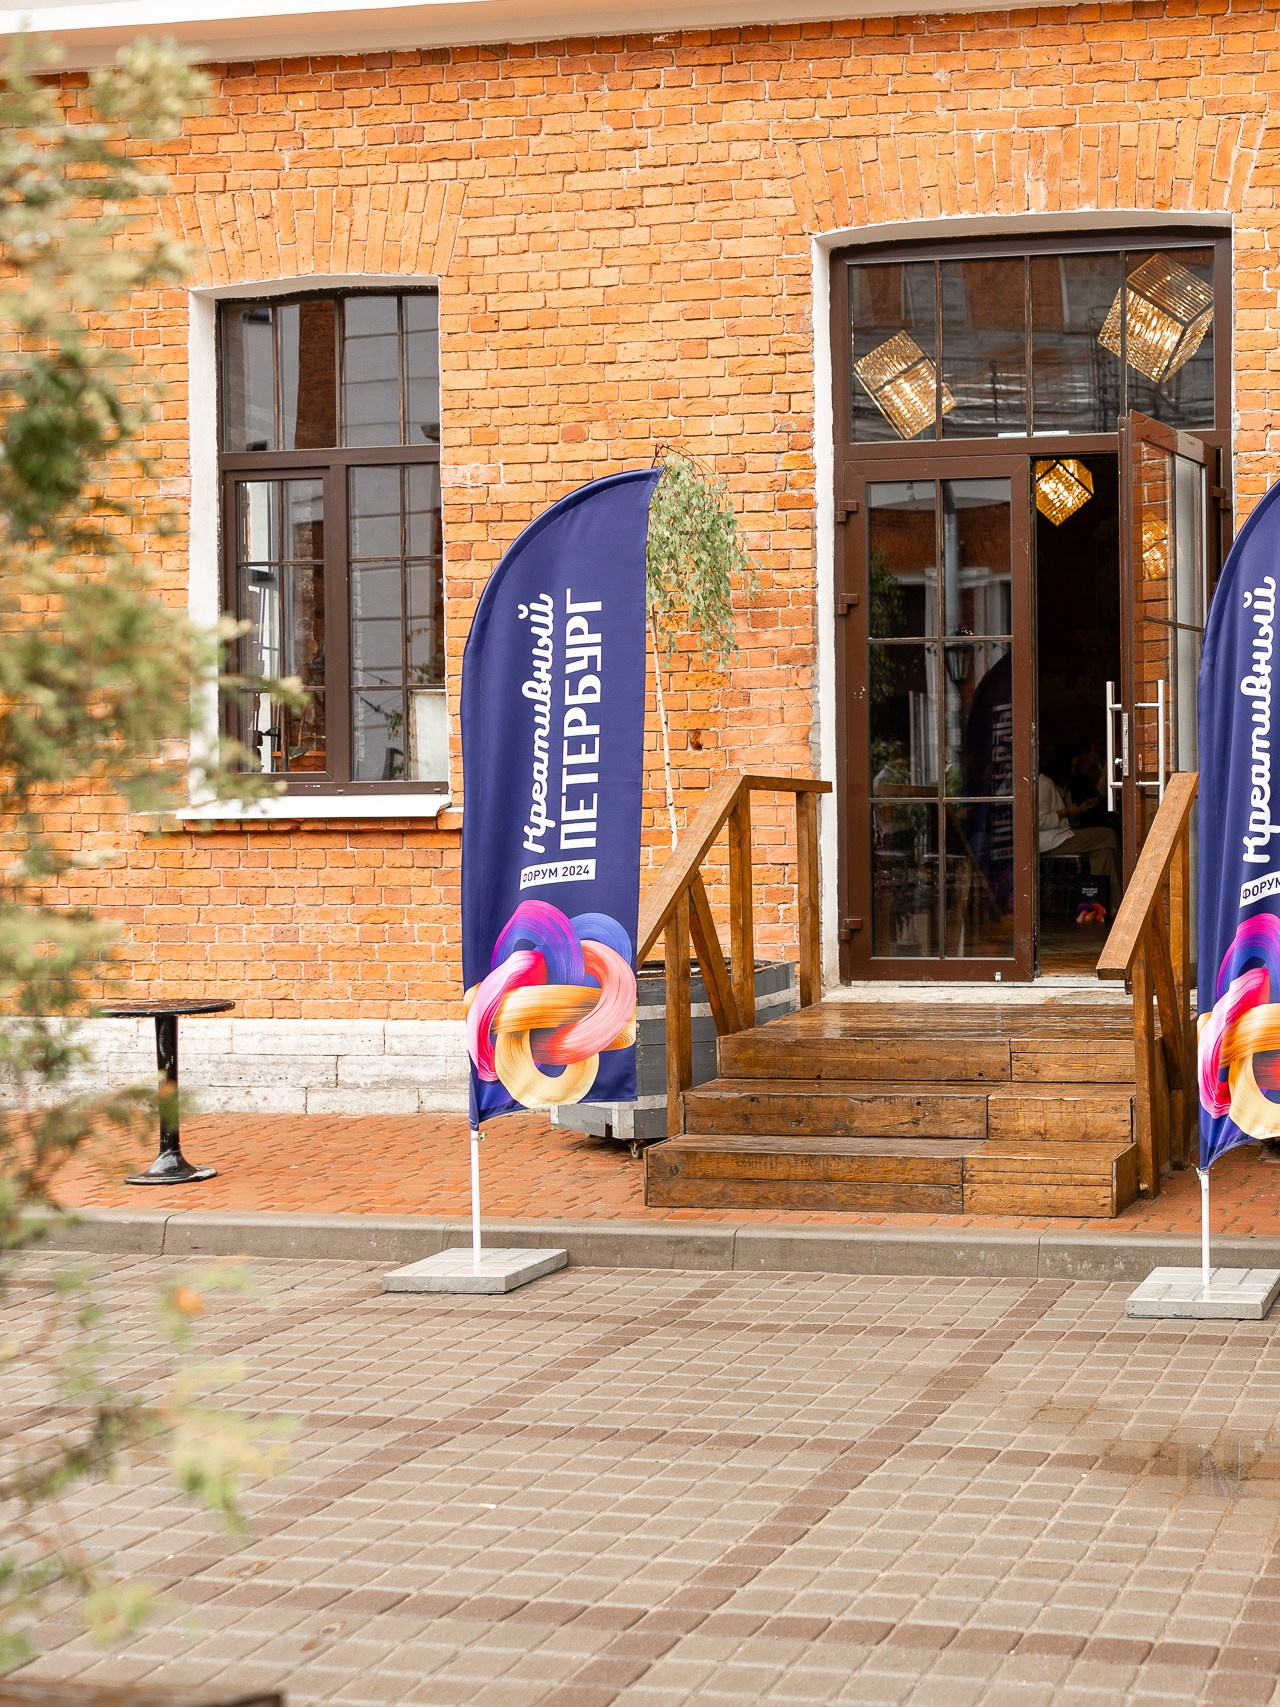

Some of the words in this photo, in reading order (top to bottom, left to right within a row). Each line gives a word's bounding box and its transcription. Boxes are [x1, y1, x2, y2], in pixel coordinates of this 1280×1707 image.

[518, 593, 556, 853] Креативный
[560, 588, 602, 850] ПЕТЕРБУРГ
[1240, 575, 1280, 863] Креативный
[562, 864, 590, 877] 2024
